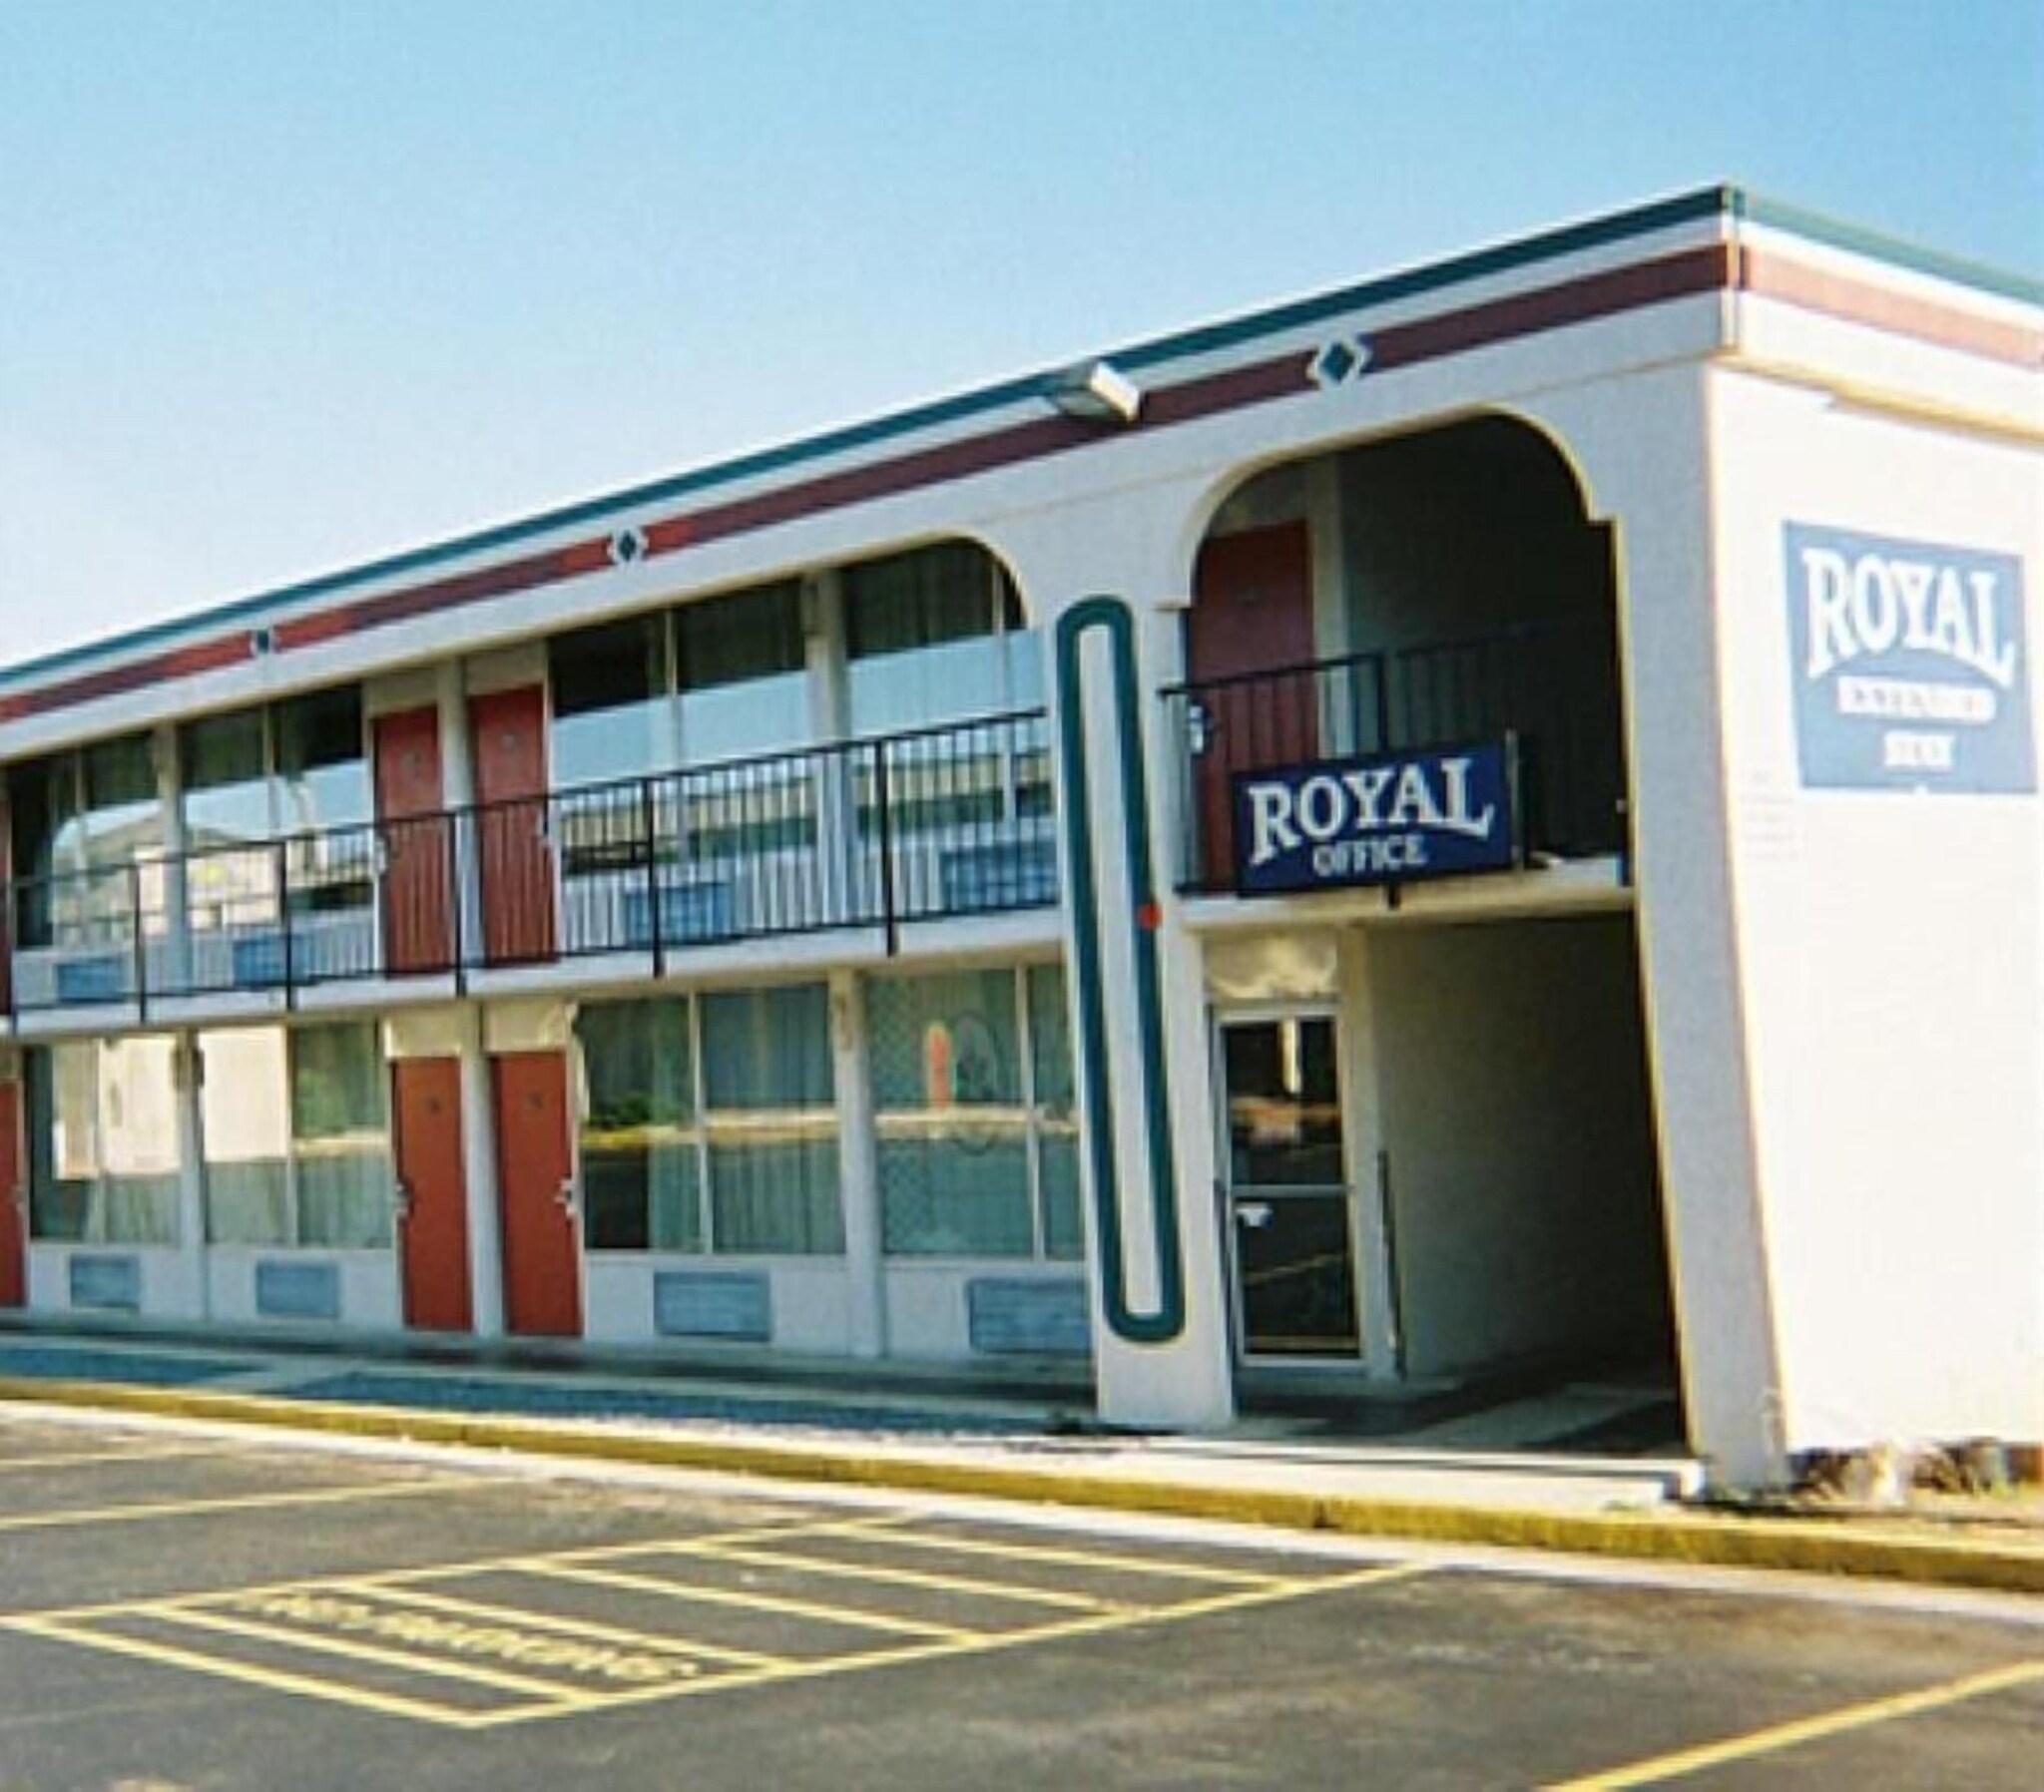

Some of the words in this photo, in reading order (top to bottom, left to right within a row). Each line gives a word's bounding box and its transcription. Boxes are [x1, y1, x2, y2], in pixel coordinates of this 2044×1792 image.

[1801, 547, 2015, 688] ROYAL
[1248, 756, 1495, 865] ROYAL
[1312, 834, 1427, 877] OFFICE
